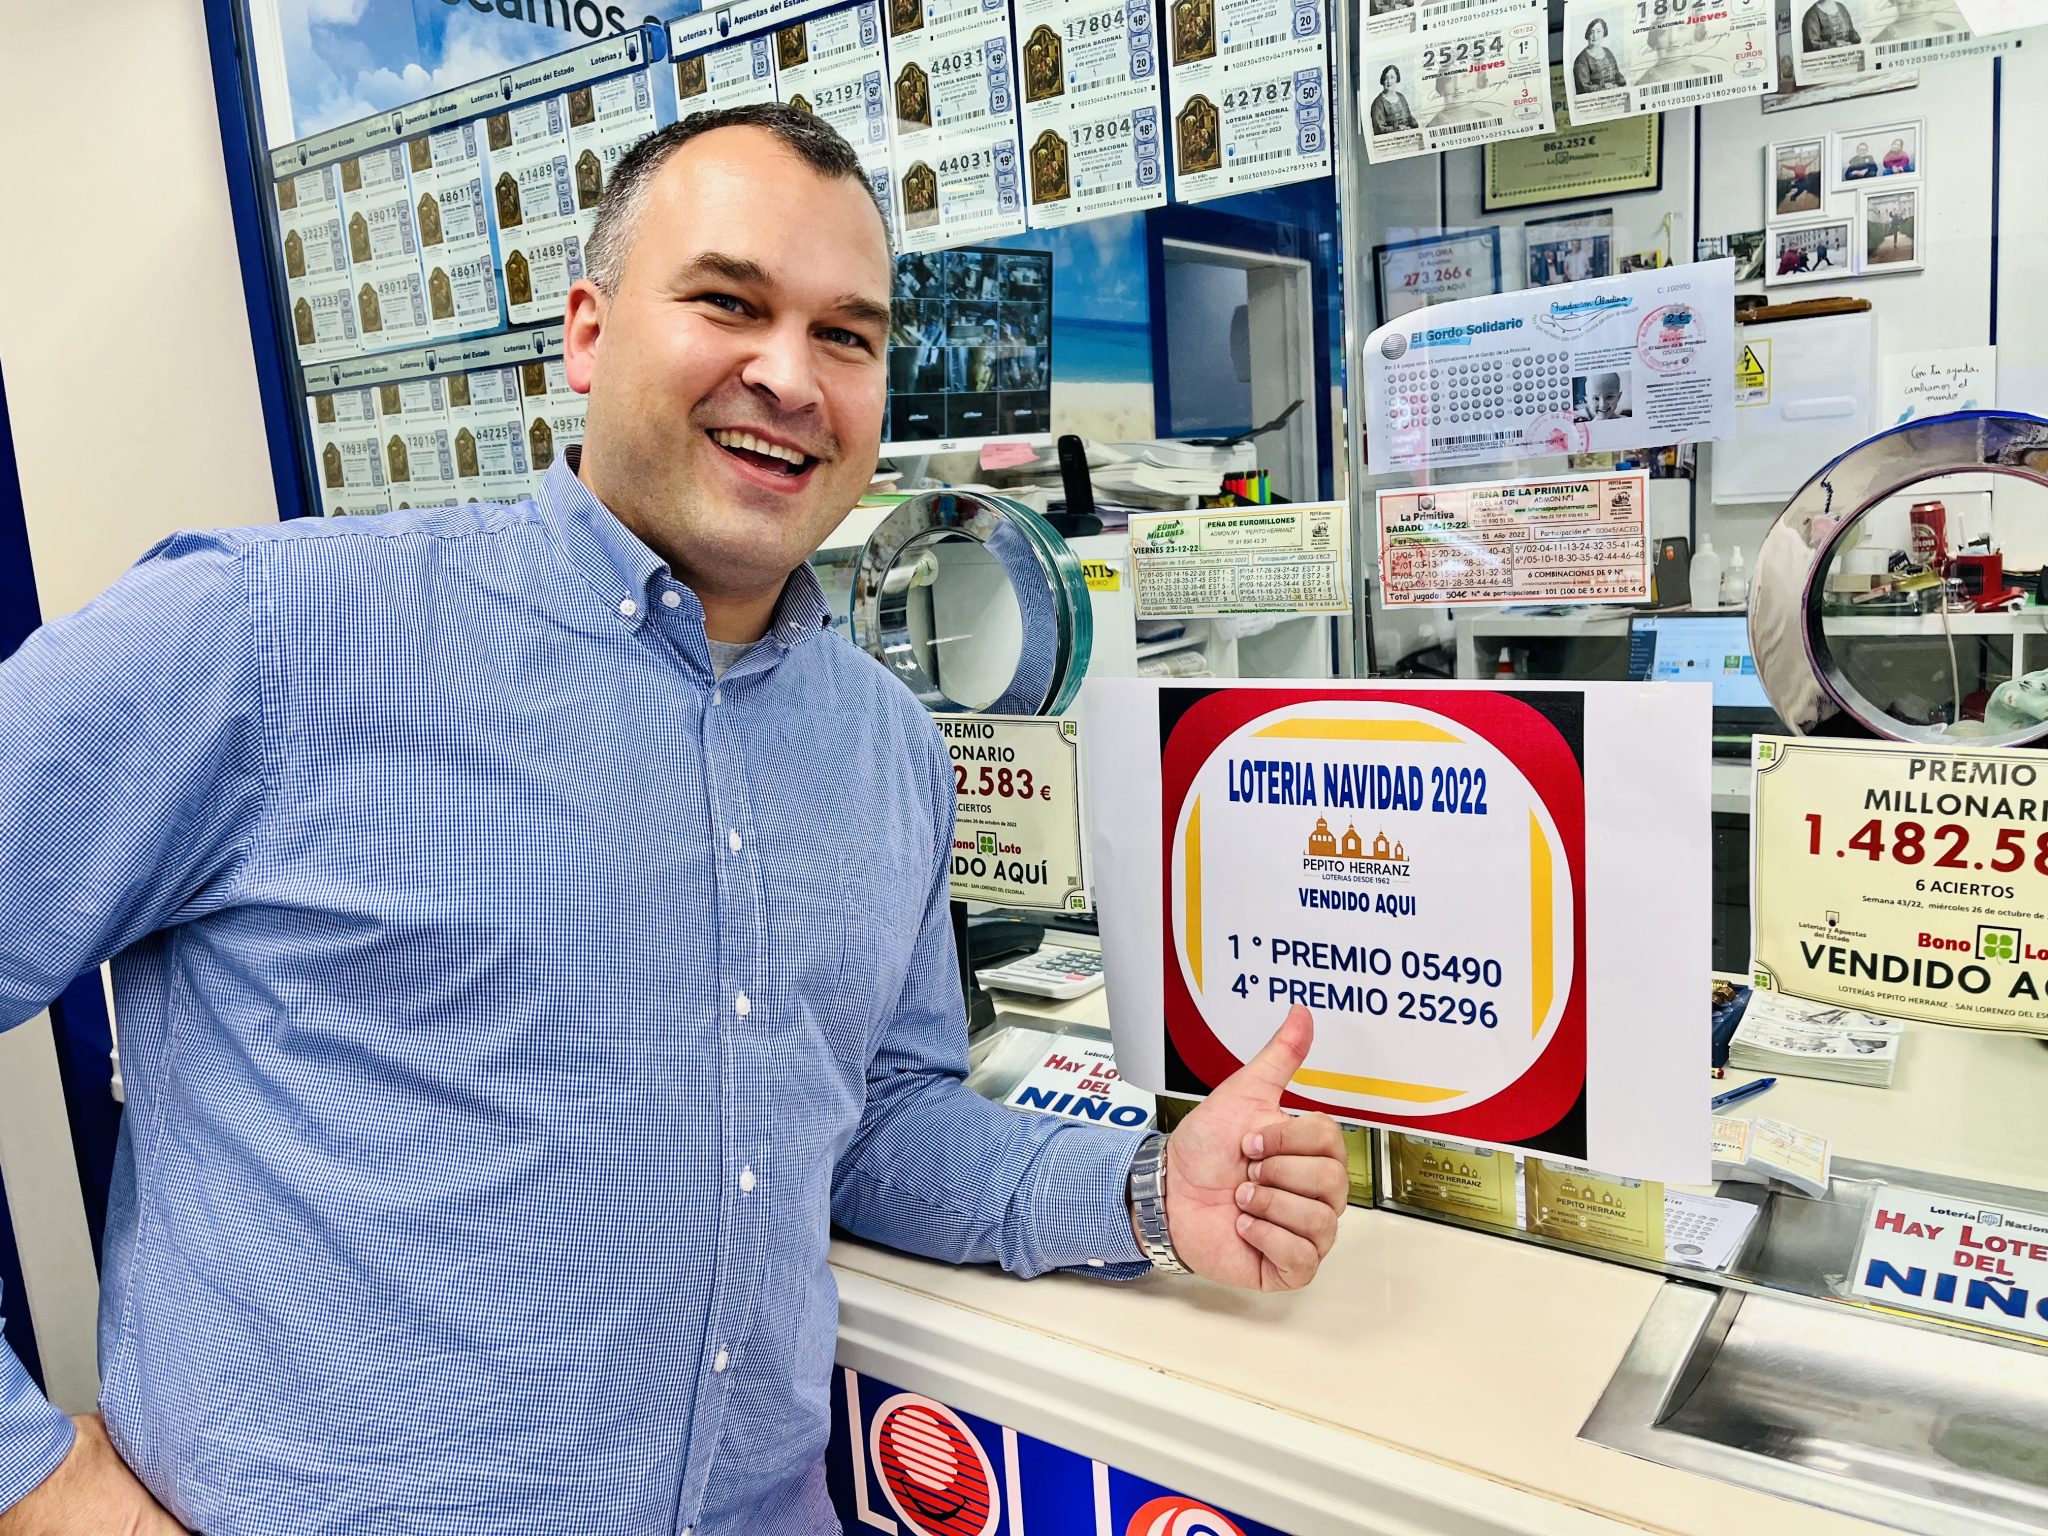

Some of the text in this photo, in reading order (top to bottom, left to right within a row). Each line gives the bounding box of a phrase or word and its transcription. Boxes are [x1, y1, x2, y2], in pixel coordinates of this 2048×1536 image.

[734, 2, 782, 26] Apuestas del
[1265, 10, 1277, 18] 2023
[1300, 16, 1311, 26] 20
[1686, 11, 1728, 25] Jueves
[1066, 10, 1125, 38] 17804
[1422, 36, 1503, 68] 25254
[1745, 42, 1752, 51] 3
[931, 49, 983, 75] 44031
[1736, 50, 1763, 60] EUROS
[1468, 60, 1506, 73] Jueves
[514, 65, 574, 90] Apuestas del Estado
[956, 72, 982, 83] NACIONAL
[815, 82, 862, 107] 52197
[1223, 81, 1291, 108] 42787
[1514, 96, 1538, 105] EUROS
[1521, 89, 1529, 97] 3
[405, 112, 428, 125] Apuestas
[438, 103, 457, 116] Estado
[1072, 118, 1130, 144] 17804
[1305, 134, 1316, 143] 20
[339, 137, 354, 148] Estado
[1543, 136, 1597, 152] 862.252 €
[939, 150, 991, 173] 44031
[519, 164, 552, 182] 41489
[439, 186, 470, 203] 48611
[368, 207, 397, 222] 49012
[529, 244, 563, 260] 41489
[1418, 248, 1453, 259] DIPLOMA
[451, 263, 482, 278] 48611
[1404, 266, 1472, 287] 273.266 €
[378, 279, 408, 295] 49012
[1666, 283, 1691, 293] 100995
[311, 295, 339, 308] 32233
[1667, 314, 1675, 323] 2
[1411, 332, 1422, 343] El
[1426, 326, 1462, 342] Gordo
[1466, 317, 1523, 335] Solidario
[463, 349, 490, 361] del Estado
[1911, 365, 1941, 379] Con tu
[1905, 379, 1967, 394] cambiamos el
[1926, 393, 1958, 402] mundo
[476, 427, 507, 440] 64725
[1534, 485, 1589, 495] PRIMITIVA
[1239, 517, 1295, 526] EUROMILLONES
[1400, 512, 1454, 522] La Primitiva
[1147, 528, 1185, 540] MILLONES
[1157, 523, 1177, 531] EURO
[1541, 529, 1580, 537] Participación
[1133, 546, 1163, 554] VIERNES
[1165, 545, 1199, 553] 23-12-22
[1534, 570, 1594, 578] COMBINACIONES
[1413, 592, 1441, 602] jugado:
[1909, 759, 2037, 786] PREMIO
[1039, 786, 1051, 801] €
[1229, 759, 1487, 815] LOTERIA NAVIDAD 2022
[957, 803, 992, 813] CIERTOS
[1864, 789, 2048, 822] MILLONARI
[999, 842, 1021, 854] Loto
[994, 859, 1048, 885] AQUÍ
[1303, 859, 1410, 877] PEPITO HERRANZ
[1322, 874, 1352, 882] LOTERIAS
[1374, 877, 1390, 885] 1962
[1915, 879, 2014, 899] 6 ACIERTOS
[1298, 888, 1416, 918] VENDIDO AQUI
[1862, 895, 1895, 906] Semana
[1928, 902, 1970, 914] miércoles
[1972, 906, 1982, 914] 26
[1997, 909, 2031, 919] octubre
[2032, 912, 2045, 920] de
[1826, 933, 1850, 944] Estado
[1834, 927, 1867, 939] Apuestas
[1917, 932, 1971, 952] Bono
[1271, 938, 1391, 976] PREMIO
[1401, 950, 1502, 988] 05490
[1800, 941, 1991, 994] VENDIDO
[1269, 976, 1388, 1016] PREMIO
[1397, 991, 1499, 1029] 25296
[1838, 984, 2034, 1018] LOTERÍAS PEPITO HERRANZ SAN LORENZO DEL
[1077, 1079, 1111, 1094] DEL
[1015, 1087, 1148, 1126] NIÑO
[1419, 1170, 1482, 1187] PEPITO HERRANZ
[1557, 1197, 1585, 1208] PEPITO
[1587, 1205, 1626, 1218] HERRANZ
[1953, 1251, 2014, 1276] DEL
[1865, 1258, 2048, 1322] NIÑ
